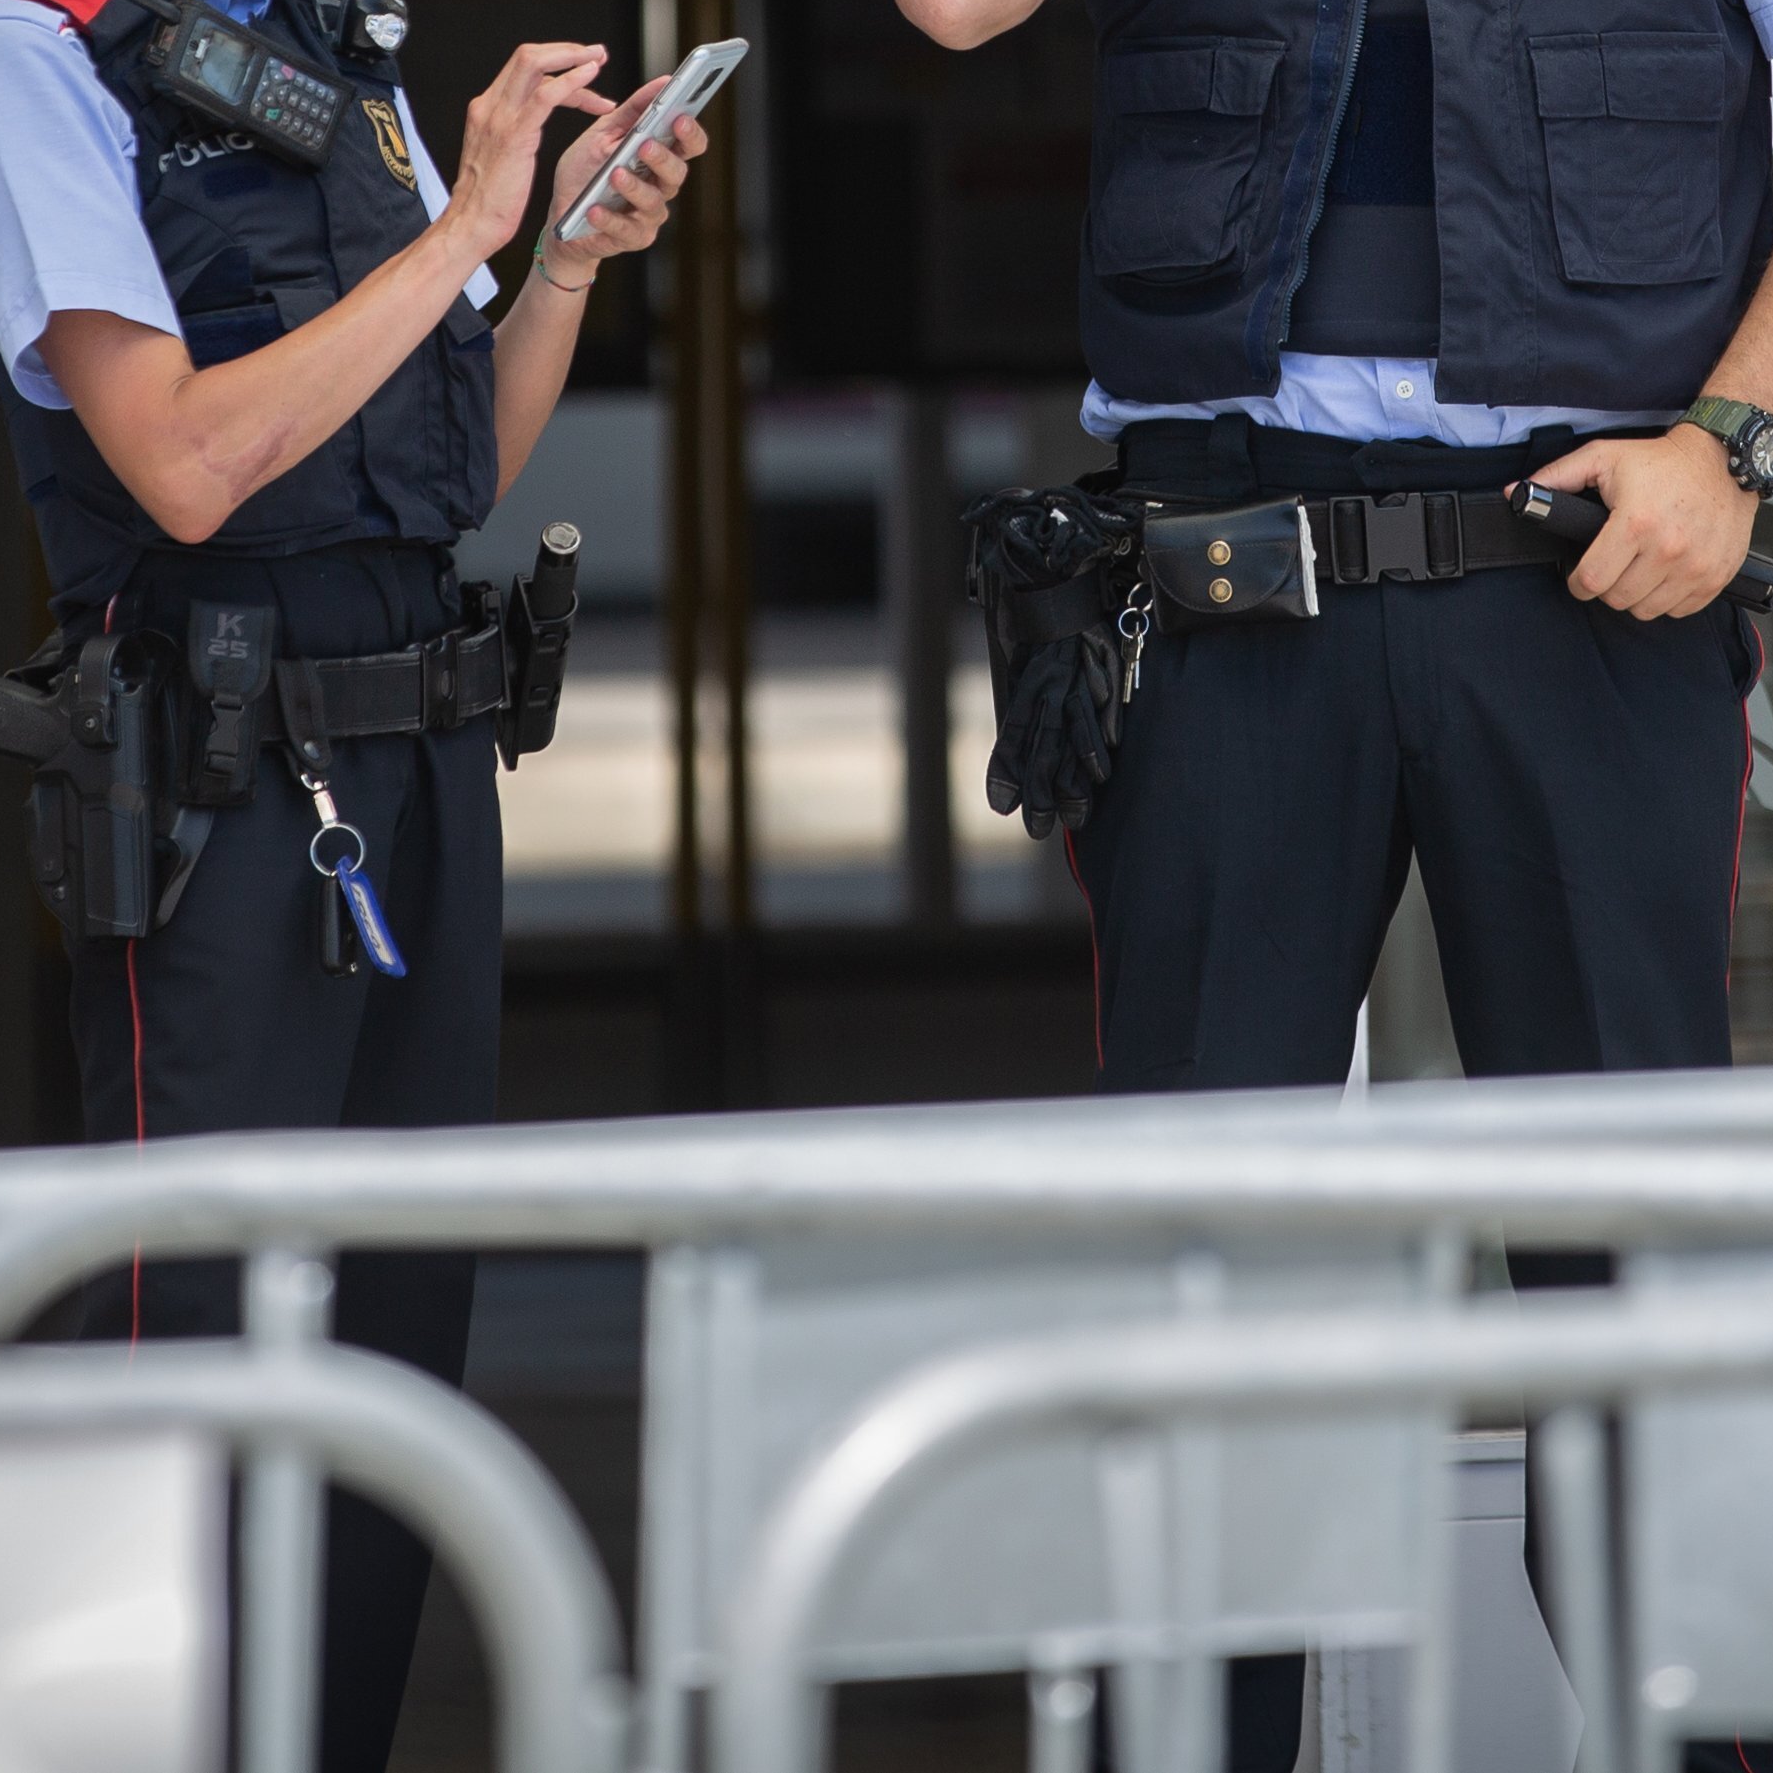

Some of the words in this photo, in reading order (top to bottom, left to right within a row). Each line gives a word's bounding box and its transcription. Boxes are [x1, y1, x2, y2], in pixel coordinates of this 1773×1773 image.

[158, 131, 254, 174] POLIC
[217, 612, 245, 638] K
[208, 638, 248, 659] 25
